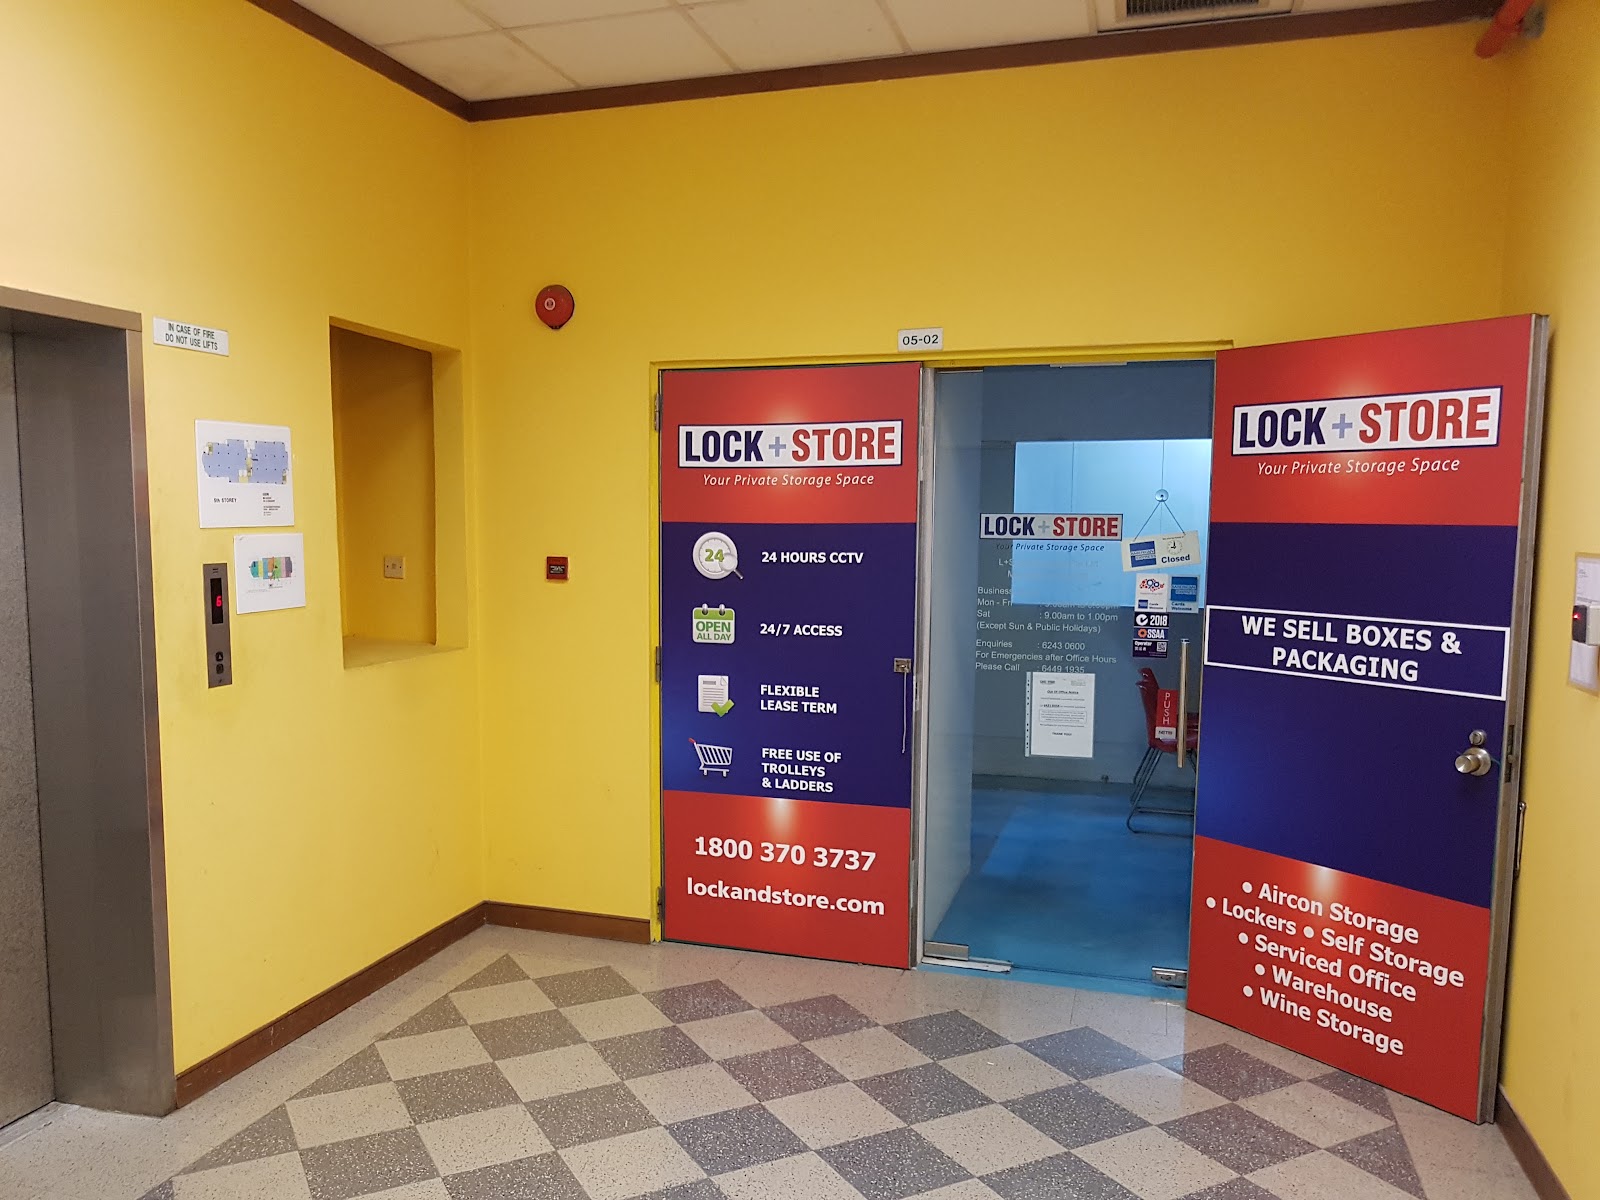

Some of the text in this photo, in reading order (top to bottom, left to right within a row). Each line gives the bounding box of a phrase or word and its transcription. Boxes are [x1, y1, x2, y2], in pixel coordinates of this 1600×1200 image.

[168, 323, 215, 339] IN CASE OF FIRE
[165, 333, 218, 350] DO NOT USE LIFTS
[902, 334, 939, 345] 05-02
[1239, 407, 1327, 448] LOCK
[1359, 395, 1491, 443] STORE
[685, 430, 764, 463] LOCK
[792, 426, 896, 461] STORE
[1257, 457, 1461, 476] Your Private Storage Space
[703, 473, 875, 488] Your Private Storage Space
[984, 516, 1035, 536] LOCK
[1053, 517, 1119, 537] STORE
[705, 549, 724, 562] 24
[1015, 543, 1044, 551] Private
[1046, 544, 1078, 553] Storage
[1080, 544, 1105, 552] Space
[761, 552, 864, 563] 24 HOURS CCTV
[1161, 554, 1191, 563] Closed
[215, 595, 223, 607] 6
[977, 598, 995, 607] Mon
[977, 610, 990, 618] Sat
[1044, 611, 1075, 620] 9.00am
[1077, 612, 1085, 620] to
[1088, 613, 1118, 622] 1.00pm
[1149, 614, 1168, 627] 2018
[695, 621, 732, 633] OPEN
[760, 623, 843, 637] 24/7 ACCESS
[976, 622, 1101, 634] (Except Sun & Public Holidays)
[1147, 629, 1165, 639] SSAA
[697, 633, 732, 642] ALL DAY
[1241, 615, 1462, 655] WE SELL BOXES &
[975, 640, 1013, 649] Enquiries
[1041, 642, 1063, 650] 6243
[1064, 642, 1086, 651] 0600
[975, 651, 1117, 664] For Emergencies after Office Hours
[1272, 646, 1419, 682] PACKAGING
[975, 662, 1003, 671] Please
[1004, 663, 1021, 672] Call
[1041, 664, 1063, 673] 6449
[1065, 665, 1086, 674] 1935
[760, 684, 820, 698] FLEXIBLE
[760, 700, 838, 714] LEASE TERM
[1162, 692, 1171, 725] PUSH
[761, 748, 842, 763] FREE USE OF
[761, 762, 826, 778] TROLLEYS
[761, 778, 834, 793] & LADDERS
[694, 836, 876, 872] 1800 370 3737
[687, 877, 885, 916] lockandstore.com
[1258, 881, 1419, 944] Aircon Storage
[1222, 898, 1465, 988] Lockers Self Storage
[1254, 933, 1416, 1002] Serviced Office
[1272, 965, 1392, 1023] Warehouse
[1259, 986, 1404, 1056] Wine Storage
